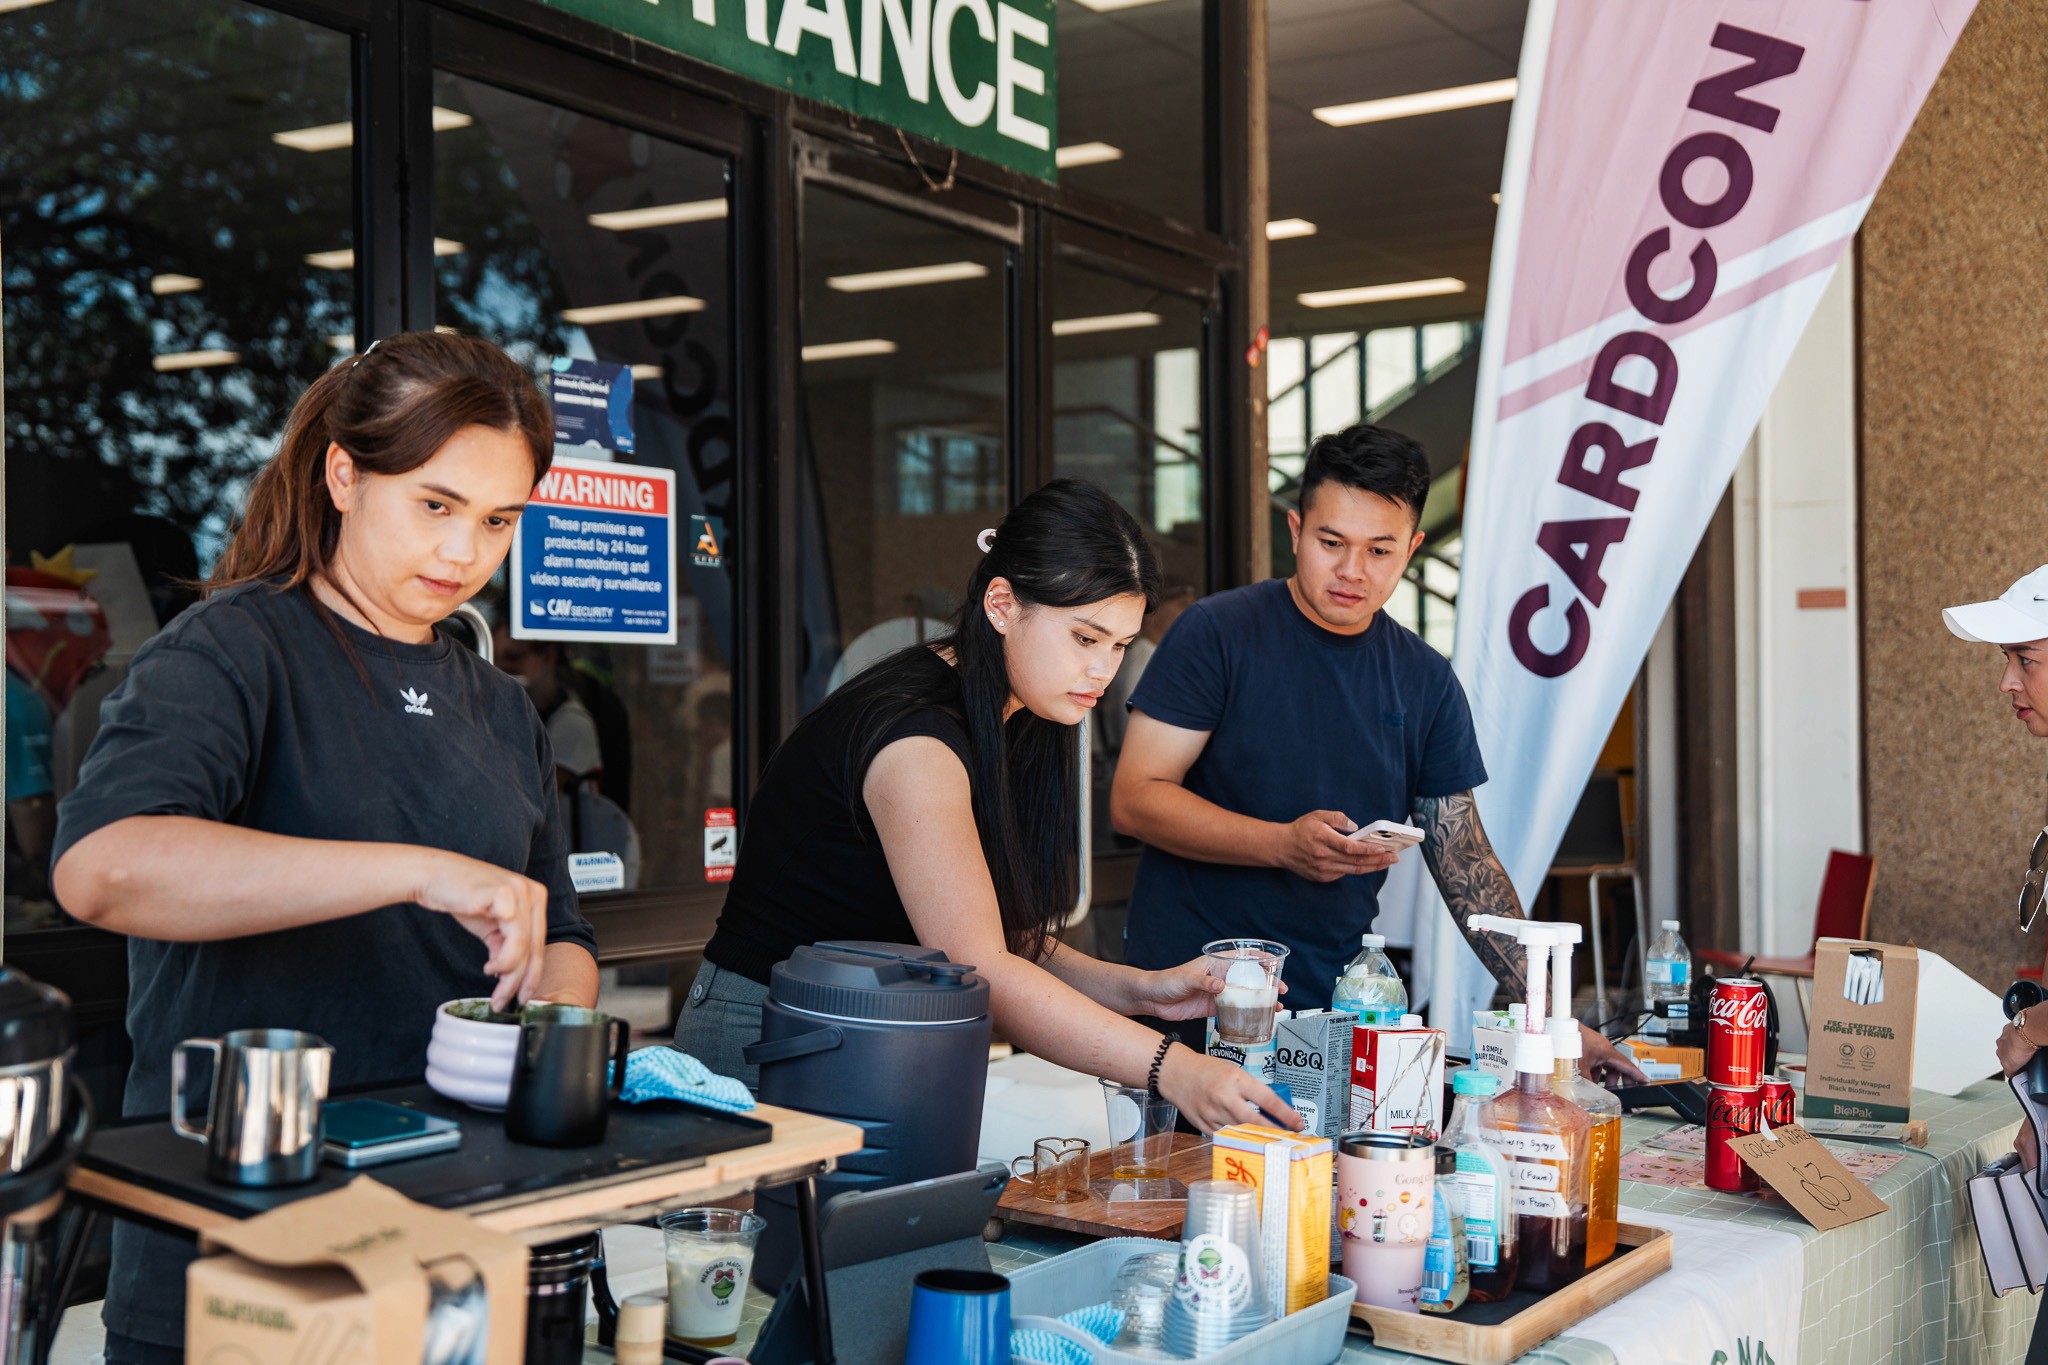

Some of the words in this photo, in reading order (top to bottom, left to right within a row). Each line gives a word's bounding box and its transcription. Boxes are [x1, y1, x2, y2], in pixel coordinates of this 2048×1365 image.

[1508, 22, 1805, 678] CARDCON
[538, 472, 654, 509] WARNING
[547, 514, 579, 532] These
[581, 518, 627, 537] premises
[628, 523, 645, 537] are
[544, 535, 594, 553] protected
[596, 538, 608, 554] by
[611, 539, 624, 553] 24
[625, 541, 647, 555] hour
[543, 553, 573, 569] alarm
[575, 557, 628, 575] monitoring
[630, 559, 649, 574] and
[530, 572, 560, 587] video
[561, 574, 602, 592] security
[603, 577, 661, 593] surveillance
[571, 605, 614, 618] SECURITY
[575, 856, 616, 867] WARNING
[1725, 1028, 1754, 1036] CLASSIC
[1823, 1024, 1853, 1035] PAPER
[1856, 1028, 1895, 1040] STRAWS
[1848, 1022, 1892, 1033] CERTIFIED
[1210, 1047, 1245, 1063] DEVONDALE
[1486, 1045, 1503, 1056] SIMPLE
[1277, 1047, 1325, 1071] Q&Q
[1475, 1052, 1488, 1060] DAIRY
[1489, 1053, 1508, 1067] SOLUTION
[1820, 1074, 1860, 1087] Individually
[1861, 1080, 1891, 1090] Wrapped
[1828, 1083, 1847, 1093] Black
[1848, 1086, 1881, 1096] BioStraws
[1833, 1104, 1872, 1119] BioPak
[1742, 1138, 1776, 1158] COKE
[1395, 1173, 1424, 1186] Gong
[1787, 1162, 1852, 1217] $3
[700, 1261, 724, 1284] MEKONG
